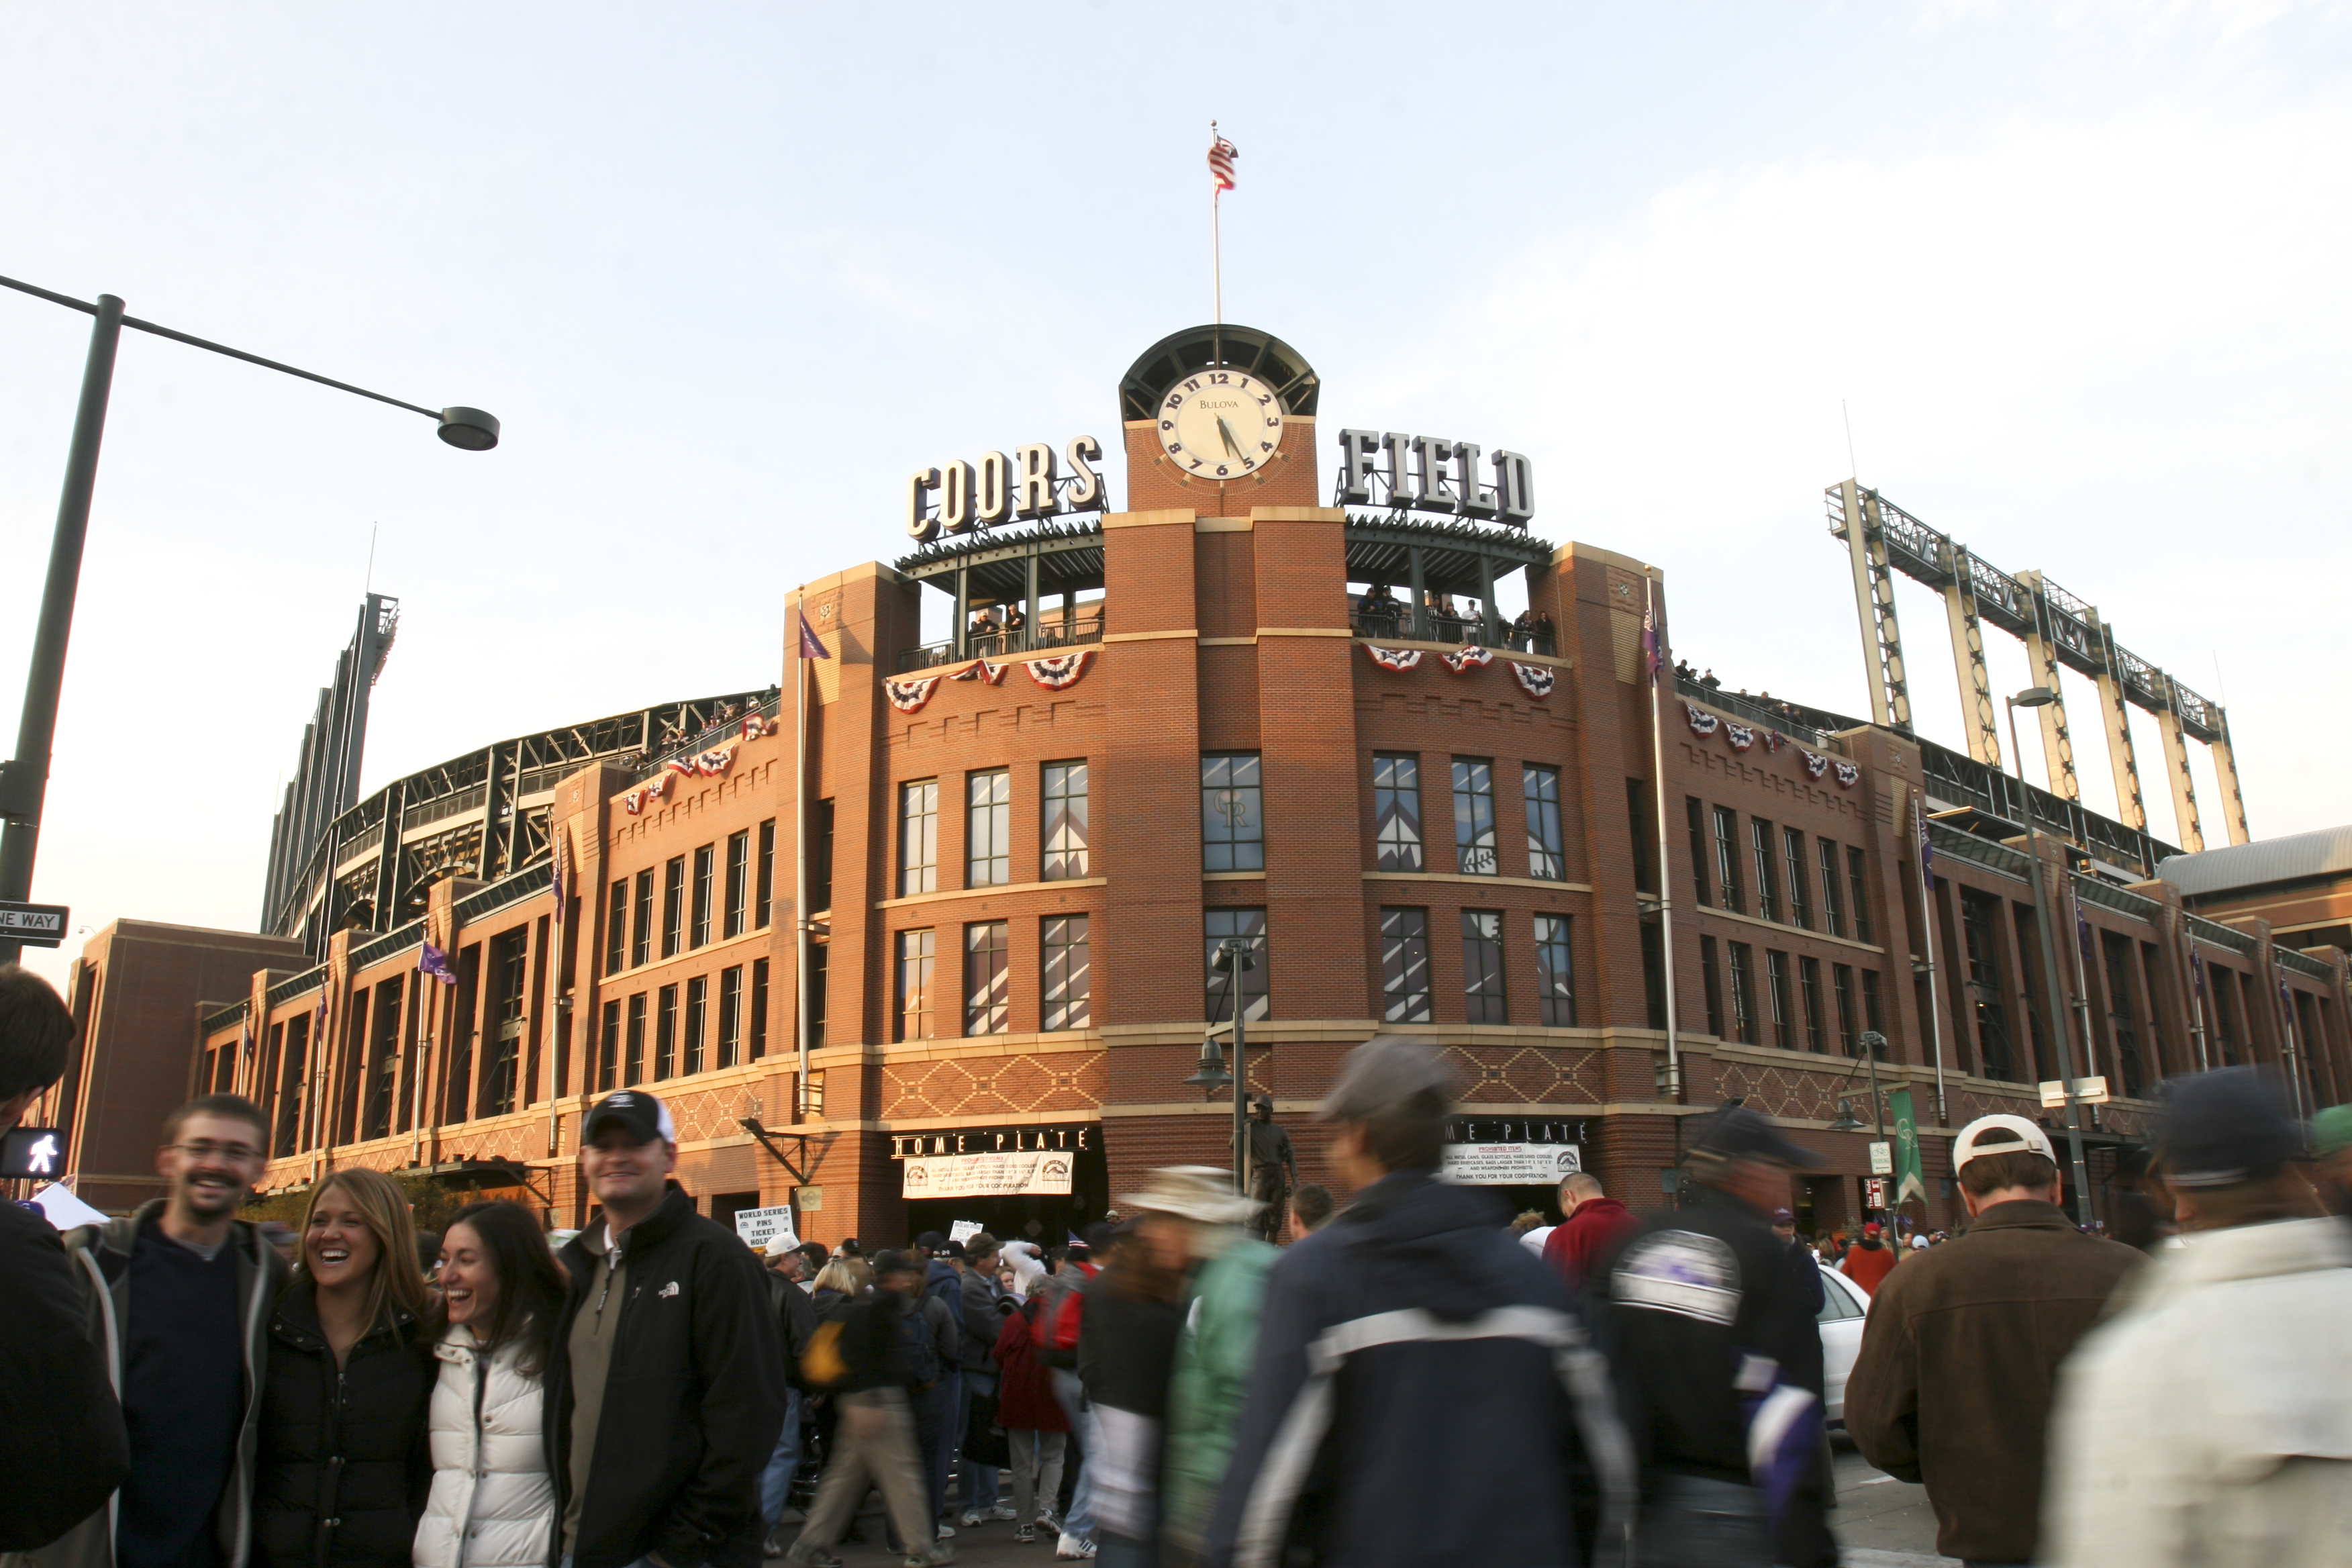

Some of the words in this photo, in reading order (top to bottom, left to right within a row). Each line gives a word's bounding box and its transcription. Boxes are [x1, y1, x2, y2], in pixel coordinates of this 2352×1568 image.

[1208, 373, 1229, 385] 12
[1240, 377, 1250, 389] 1
[1183, 379, 1202, 392] 11
[1165, 393, 1183, 410] 10
[1199, 400, 1239, 409] BULOVA
[1256, 393, 1272, 406] 2
[1161, 420, 1174, 431] 9
[1266, 417, 1279, 428] 3
[1168, 442, 1183, 454] 8
[1260, 440, 1274, 453] 4
[1188, 458, 1204, 470] 7
[1242, 456, 1255, 470] 5
[1216, 464, 1228, 476] 6
[907, 435, 1101, 541] COORS
[1339, 429, 1535, 525] FIELD
[0, 912, 15, 926] NE
[22, 914, 56, 928] WAY
[1445, 1124, 1475, 1140] ME
[1505, 1124, 1586, 1140] PLATE
[895, 1136, 965, 1155] HOME
[996, 1131, 1085, 1150] PLATE
[738, 1210, 761, 1220] WORLD
[764, 1208, 788, 1216] SERIES
[756, 1219, 772, 1227] PINS
[751, 1228, 775, 1237] TICKET
[750, 1236, 772, 1246] HOLD
